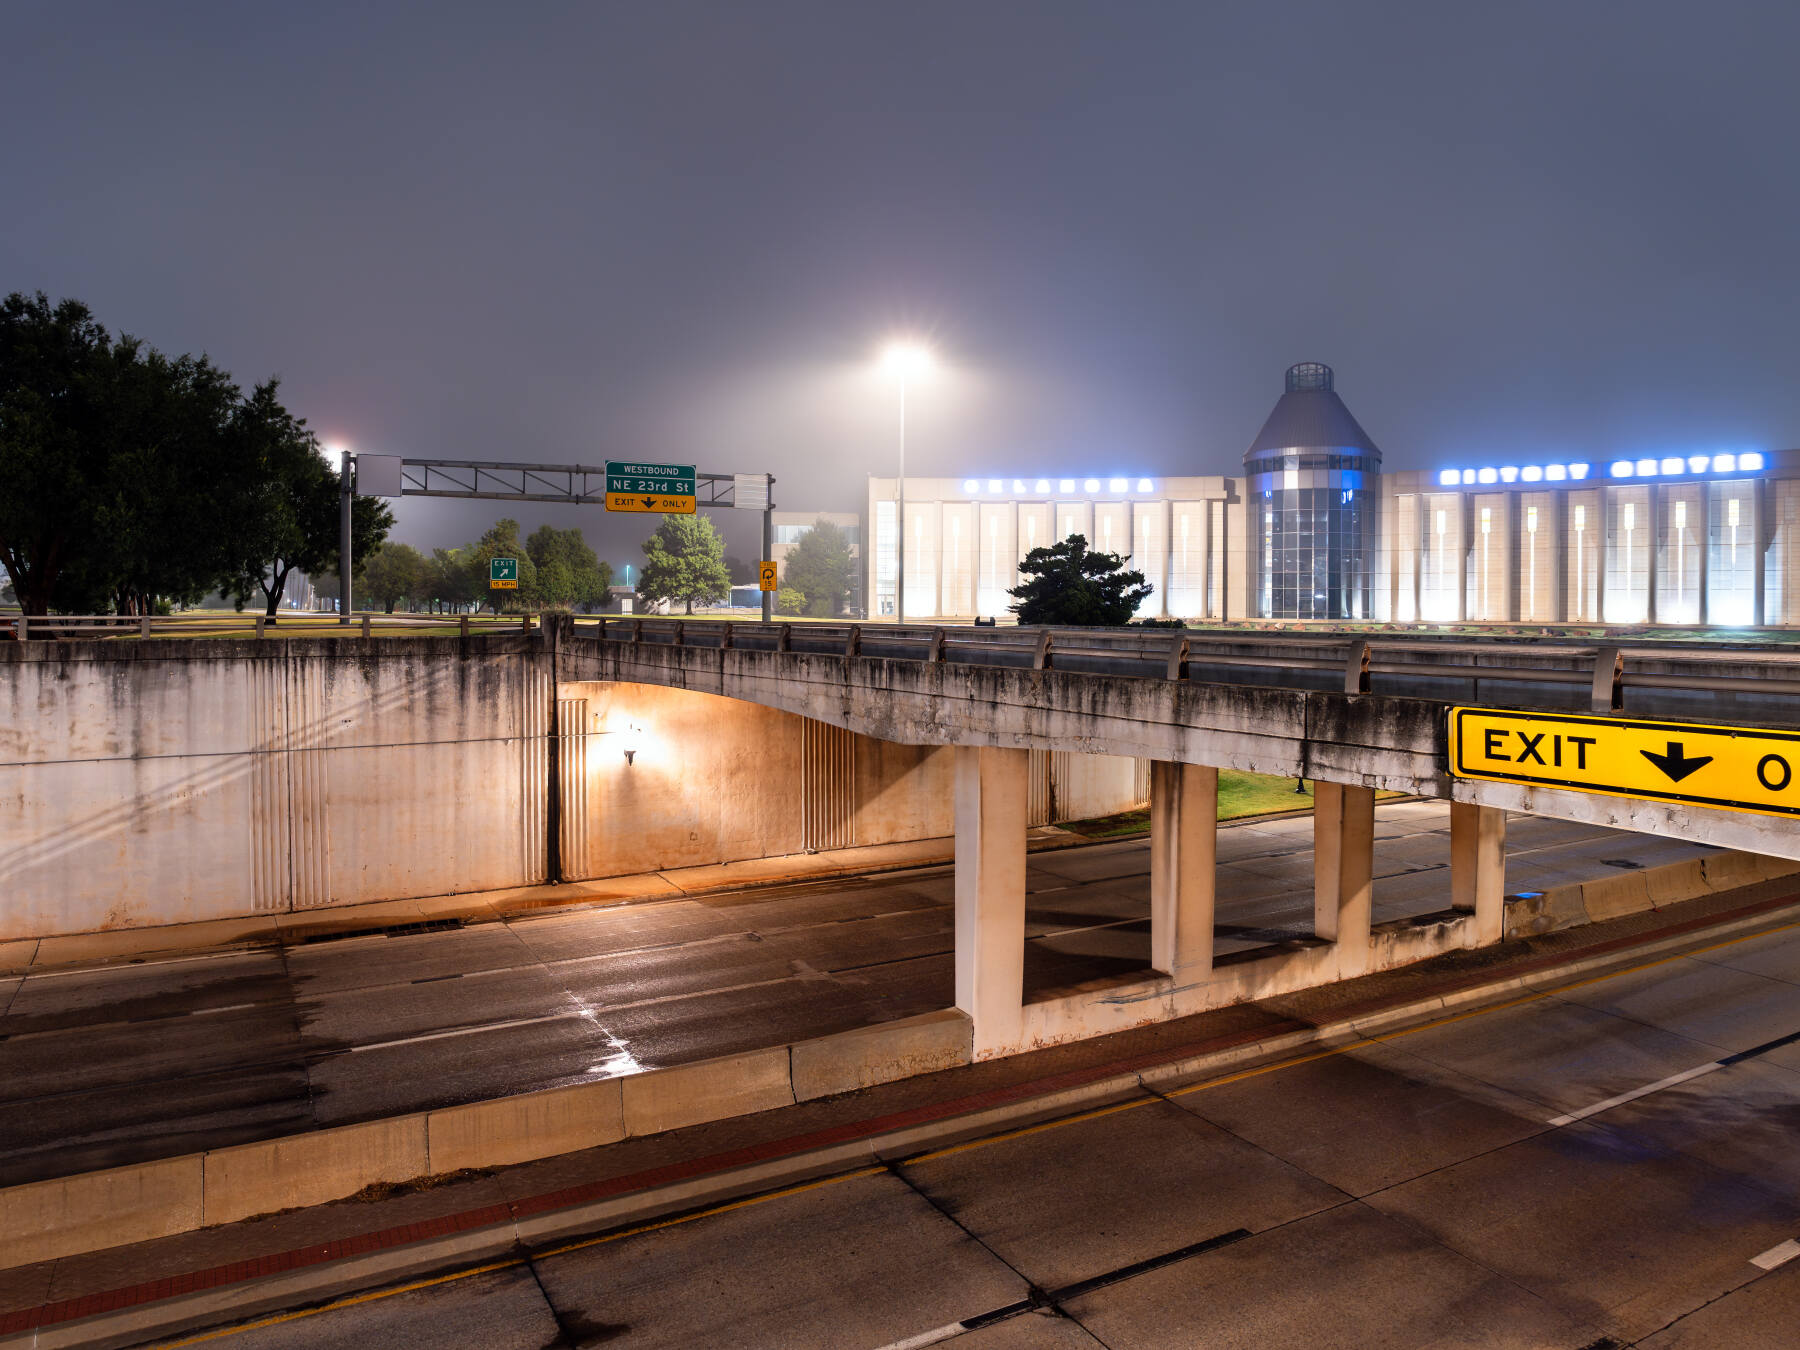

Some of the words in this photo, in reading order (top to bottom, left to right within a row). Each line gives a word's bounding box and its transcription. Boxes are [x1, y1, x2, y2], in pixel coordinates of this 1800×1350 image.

[624, 465, 679, 475] WESTBOUND
[613, 480, 631, 490] NE
[638, 481, 668, 492] 23rd
[676, 482, 689, 492] St
[615, 498, 635, 506] EXIT
[662, 500, 687, 508] ONLY
[1484, 728, 1597, 769] EXIT
[1756, 753, 1792, 792] O
